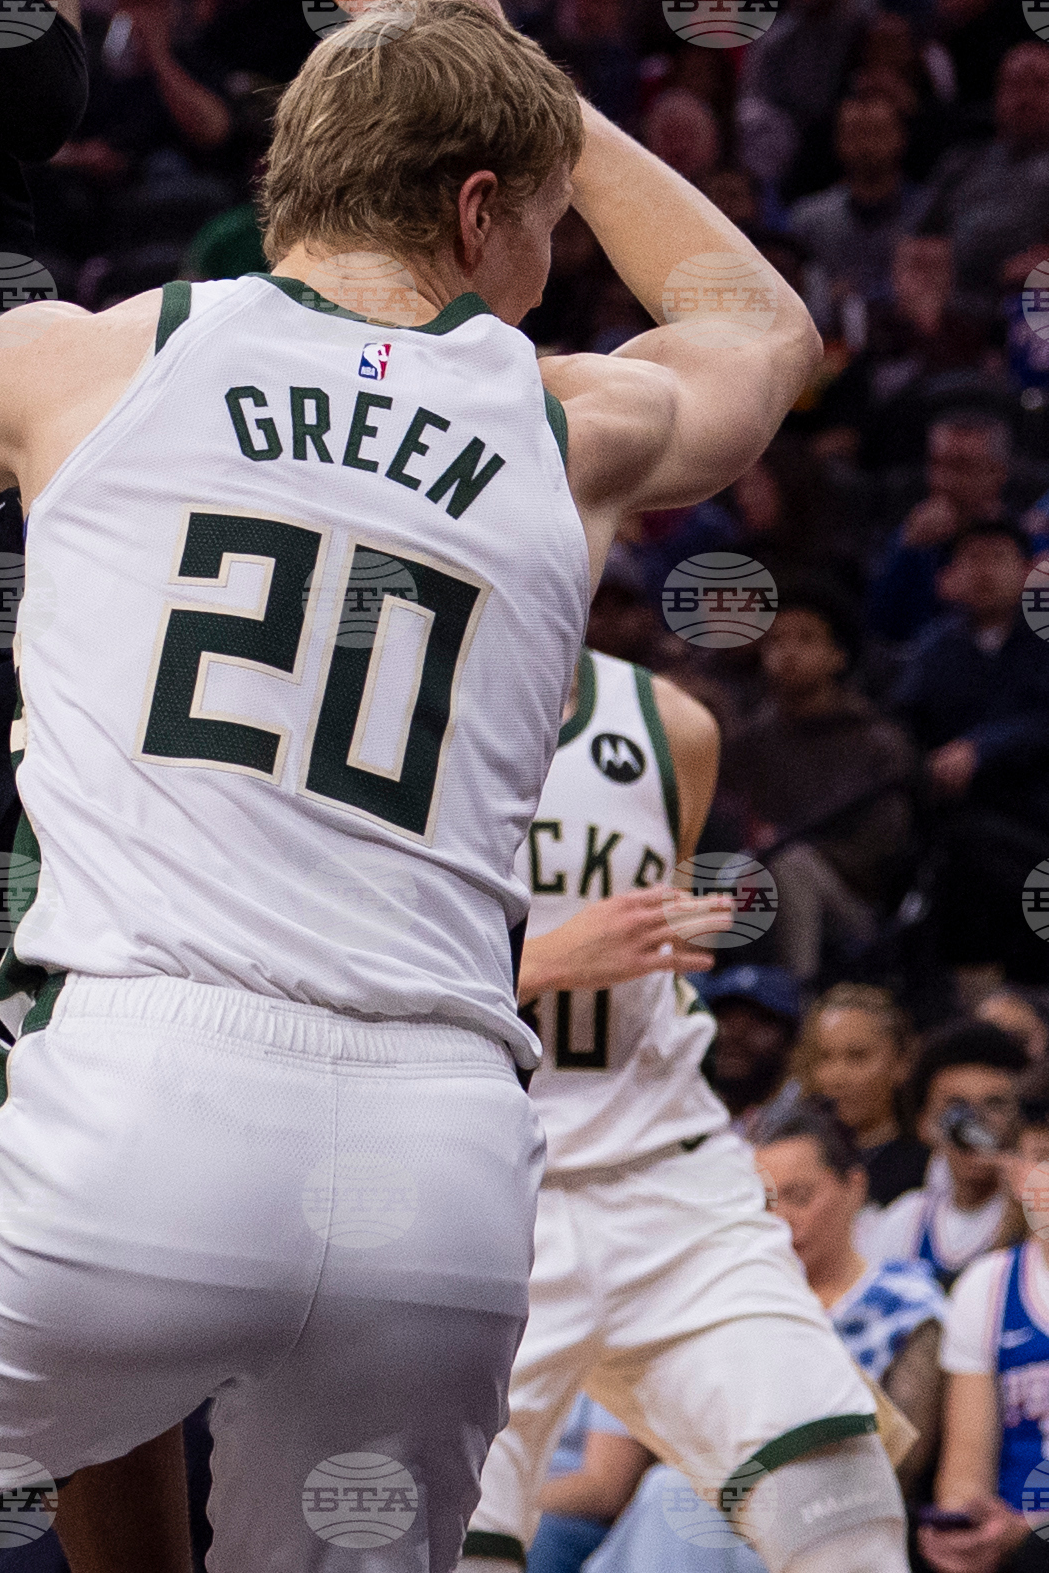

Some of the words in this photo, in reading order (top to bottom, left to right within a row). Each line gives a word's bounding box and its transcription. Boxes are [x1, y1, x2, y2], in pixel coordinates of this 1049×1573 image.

[224, 385, 507, 521] GREEN
[131, 503, 493, 848] 20
[528, 820, 666, 898] CKS
